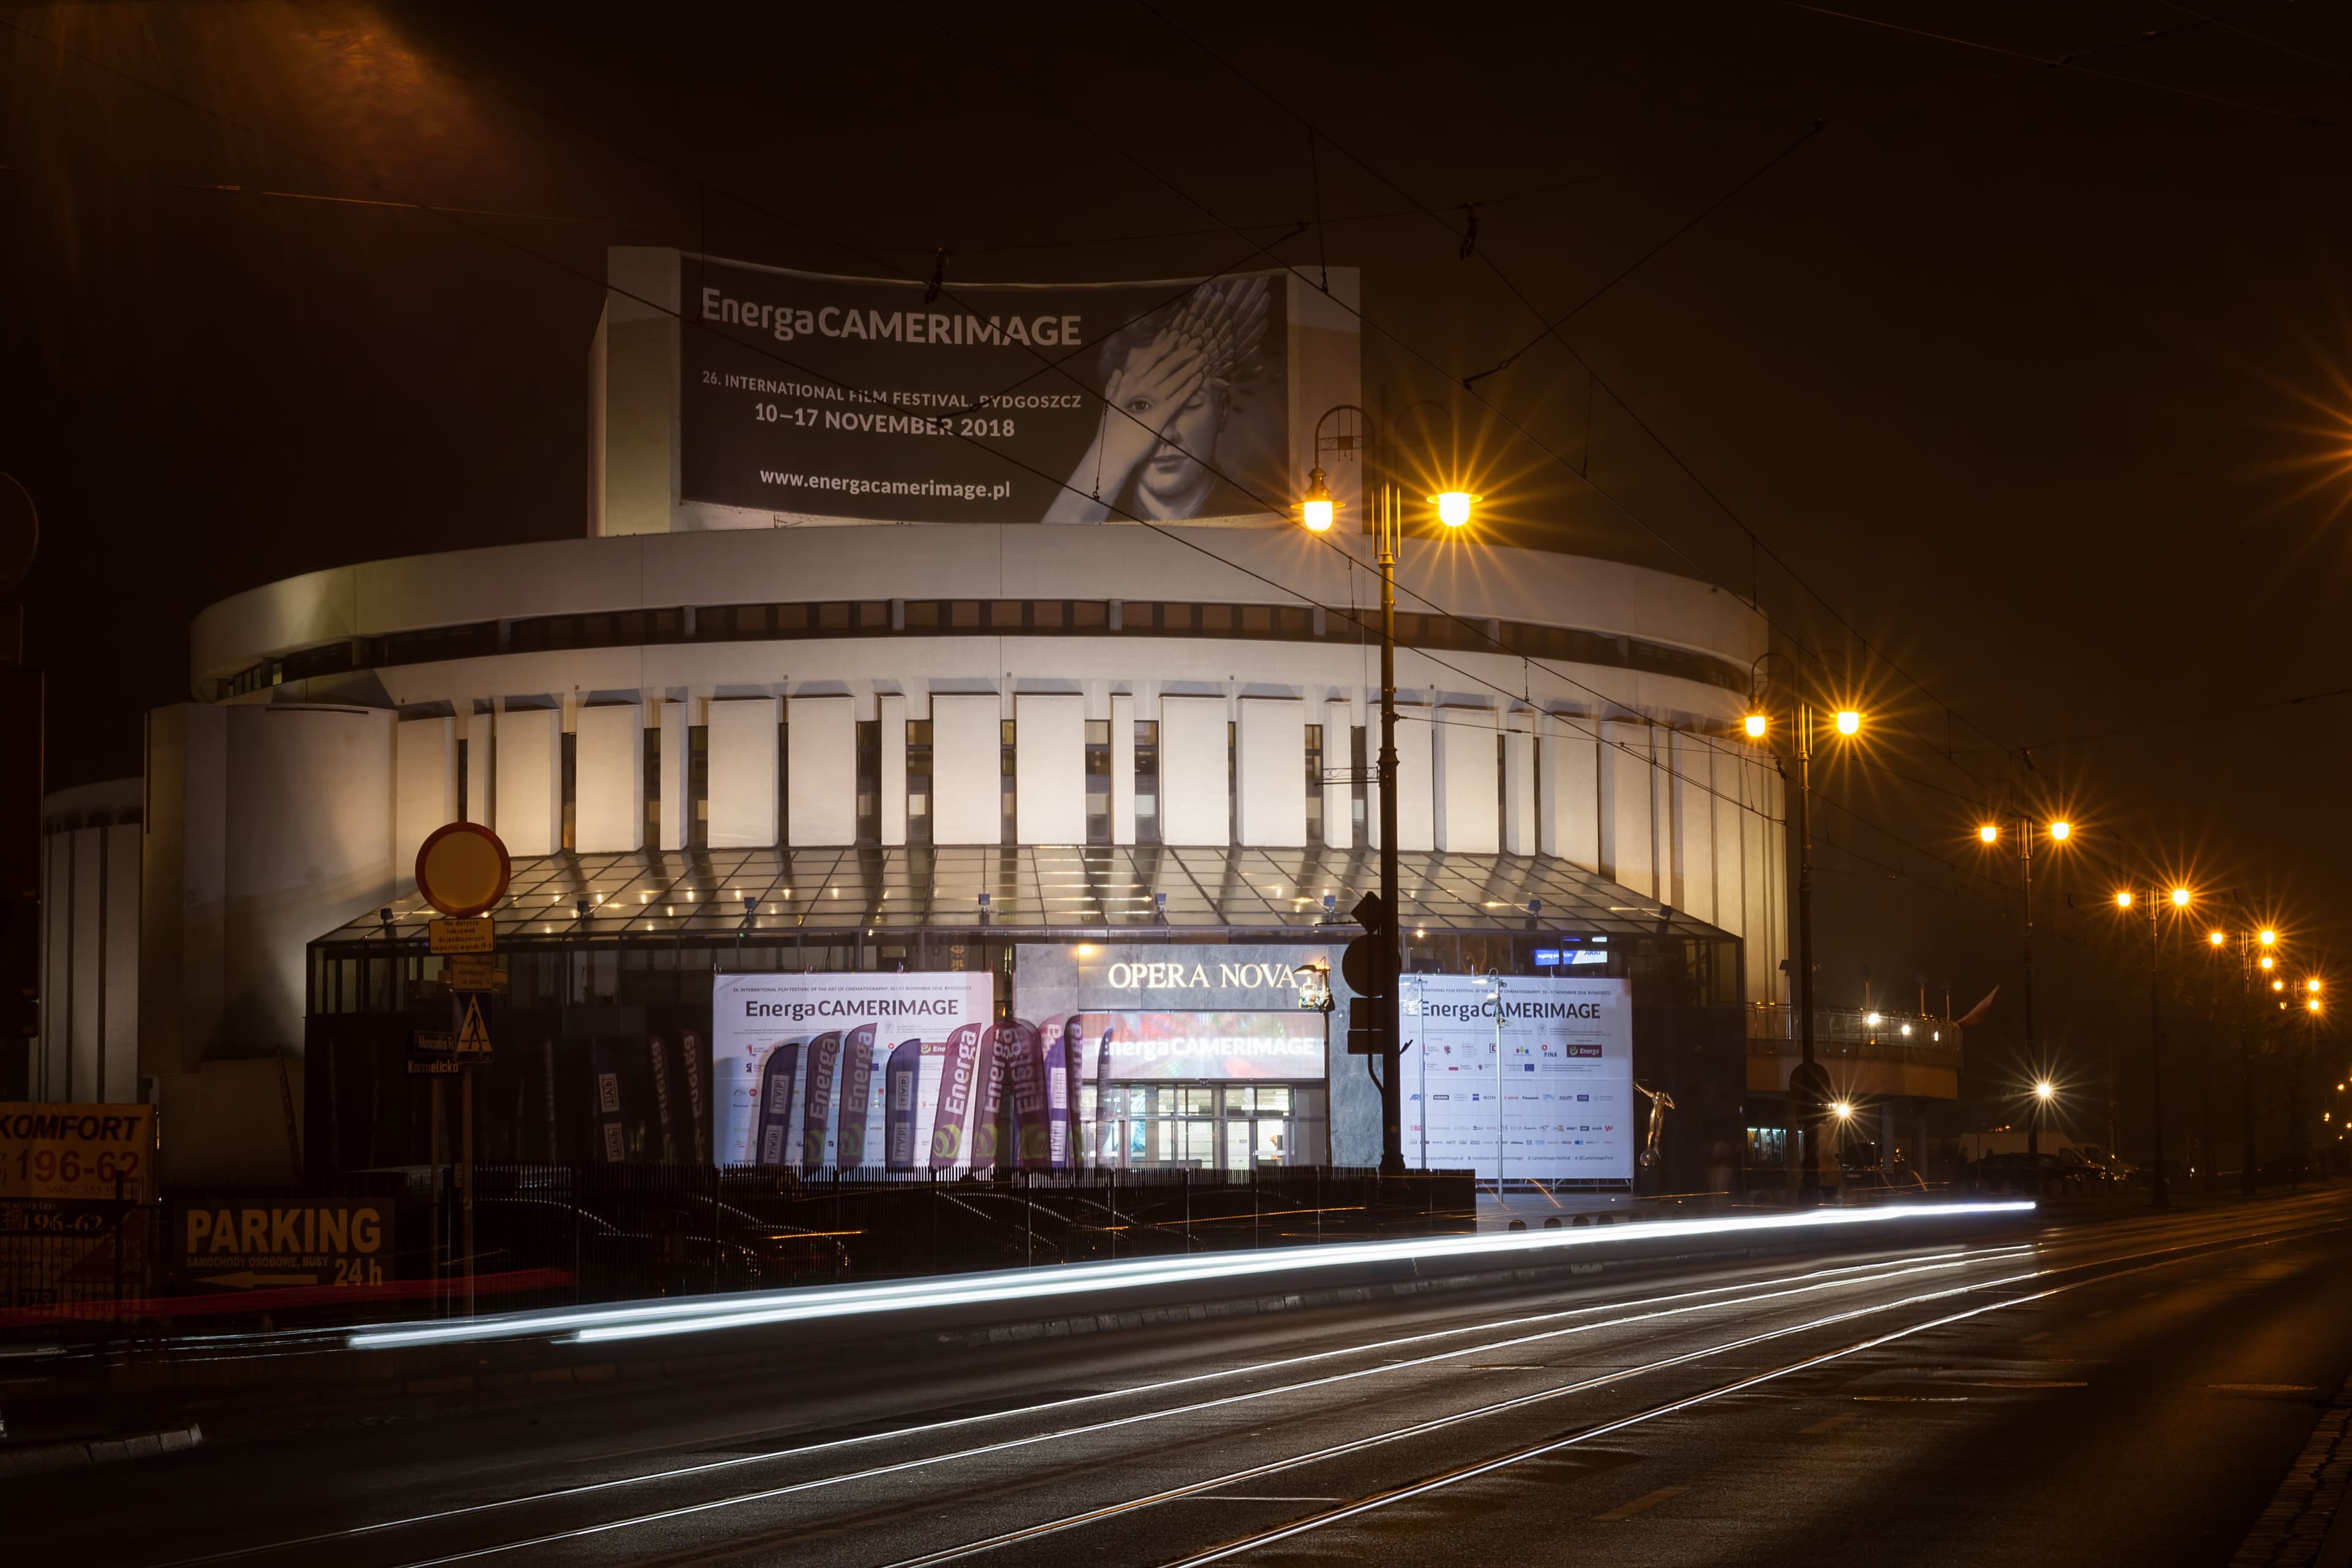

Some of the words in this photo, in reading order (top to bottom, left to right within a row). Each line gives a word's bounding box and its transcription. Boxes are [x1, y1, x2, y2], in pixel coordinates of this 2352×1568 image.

[703, 371, 721, 385] 26.
[725, 374, 844, 401] INTERNATIONAL
[850, 390, 887, 403] FILM
[979, 394, 1082, 409] BYDGOSZCZ
[826, 410, 954, 436] NOVEMBER
[960, 418, 1015, 437] 2018
[760, 470, 1010, 500] www.energacamerimage.pl
[1109, 963, 1210, 989] OPERA
[1219, 963, 1298, 989] NOVA
[745, 999, 959, 1022] EnergaCAMERIMAGE
[407, 1058, 459, 1074] Karmelicka
[810, 1038, 837, 1120] Energa
[848, 1031, 873, 1114] Energa
[944, 1030, 976, 1115] Energa
[773, 1080, 786, 1108] TVP
[899, 1077, 910, 1106] TVP
[17, 1149, 139, 1183] 196-62
[186, 1207, 382, 1254] PARKING
[186, 1256, 246, 1268] SAMOCHODY
[248, 1256, 300, 1268] OSOBOWE,
[302, 1256, 329, 1268] BUSY
[334, 1257, 363, 1287] 24
[369, 1257, 383, 1287] h
